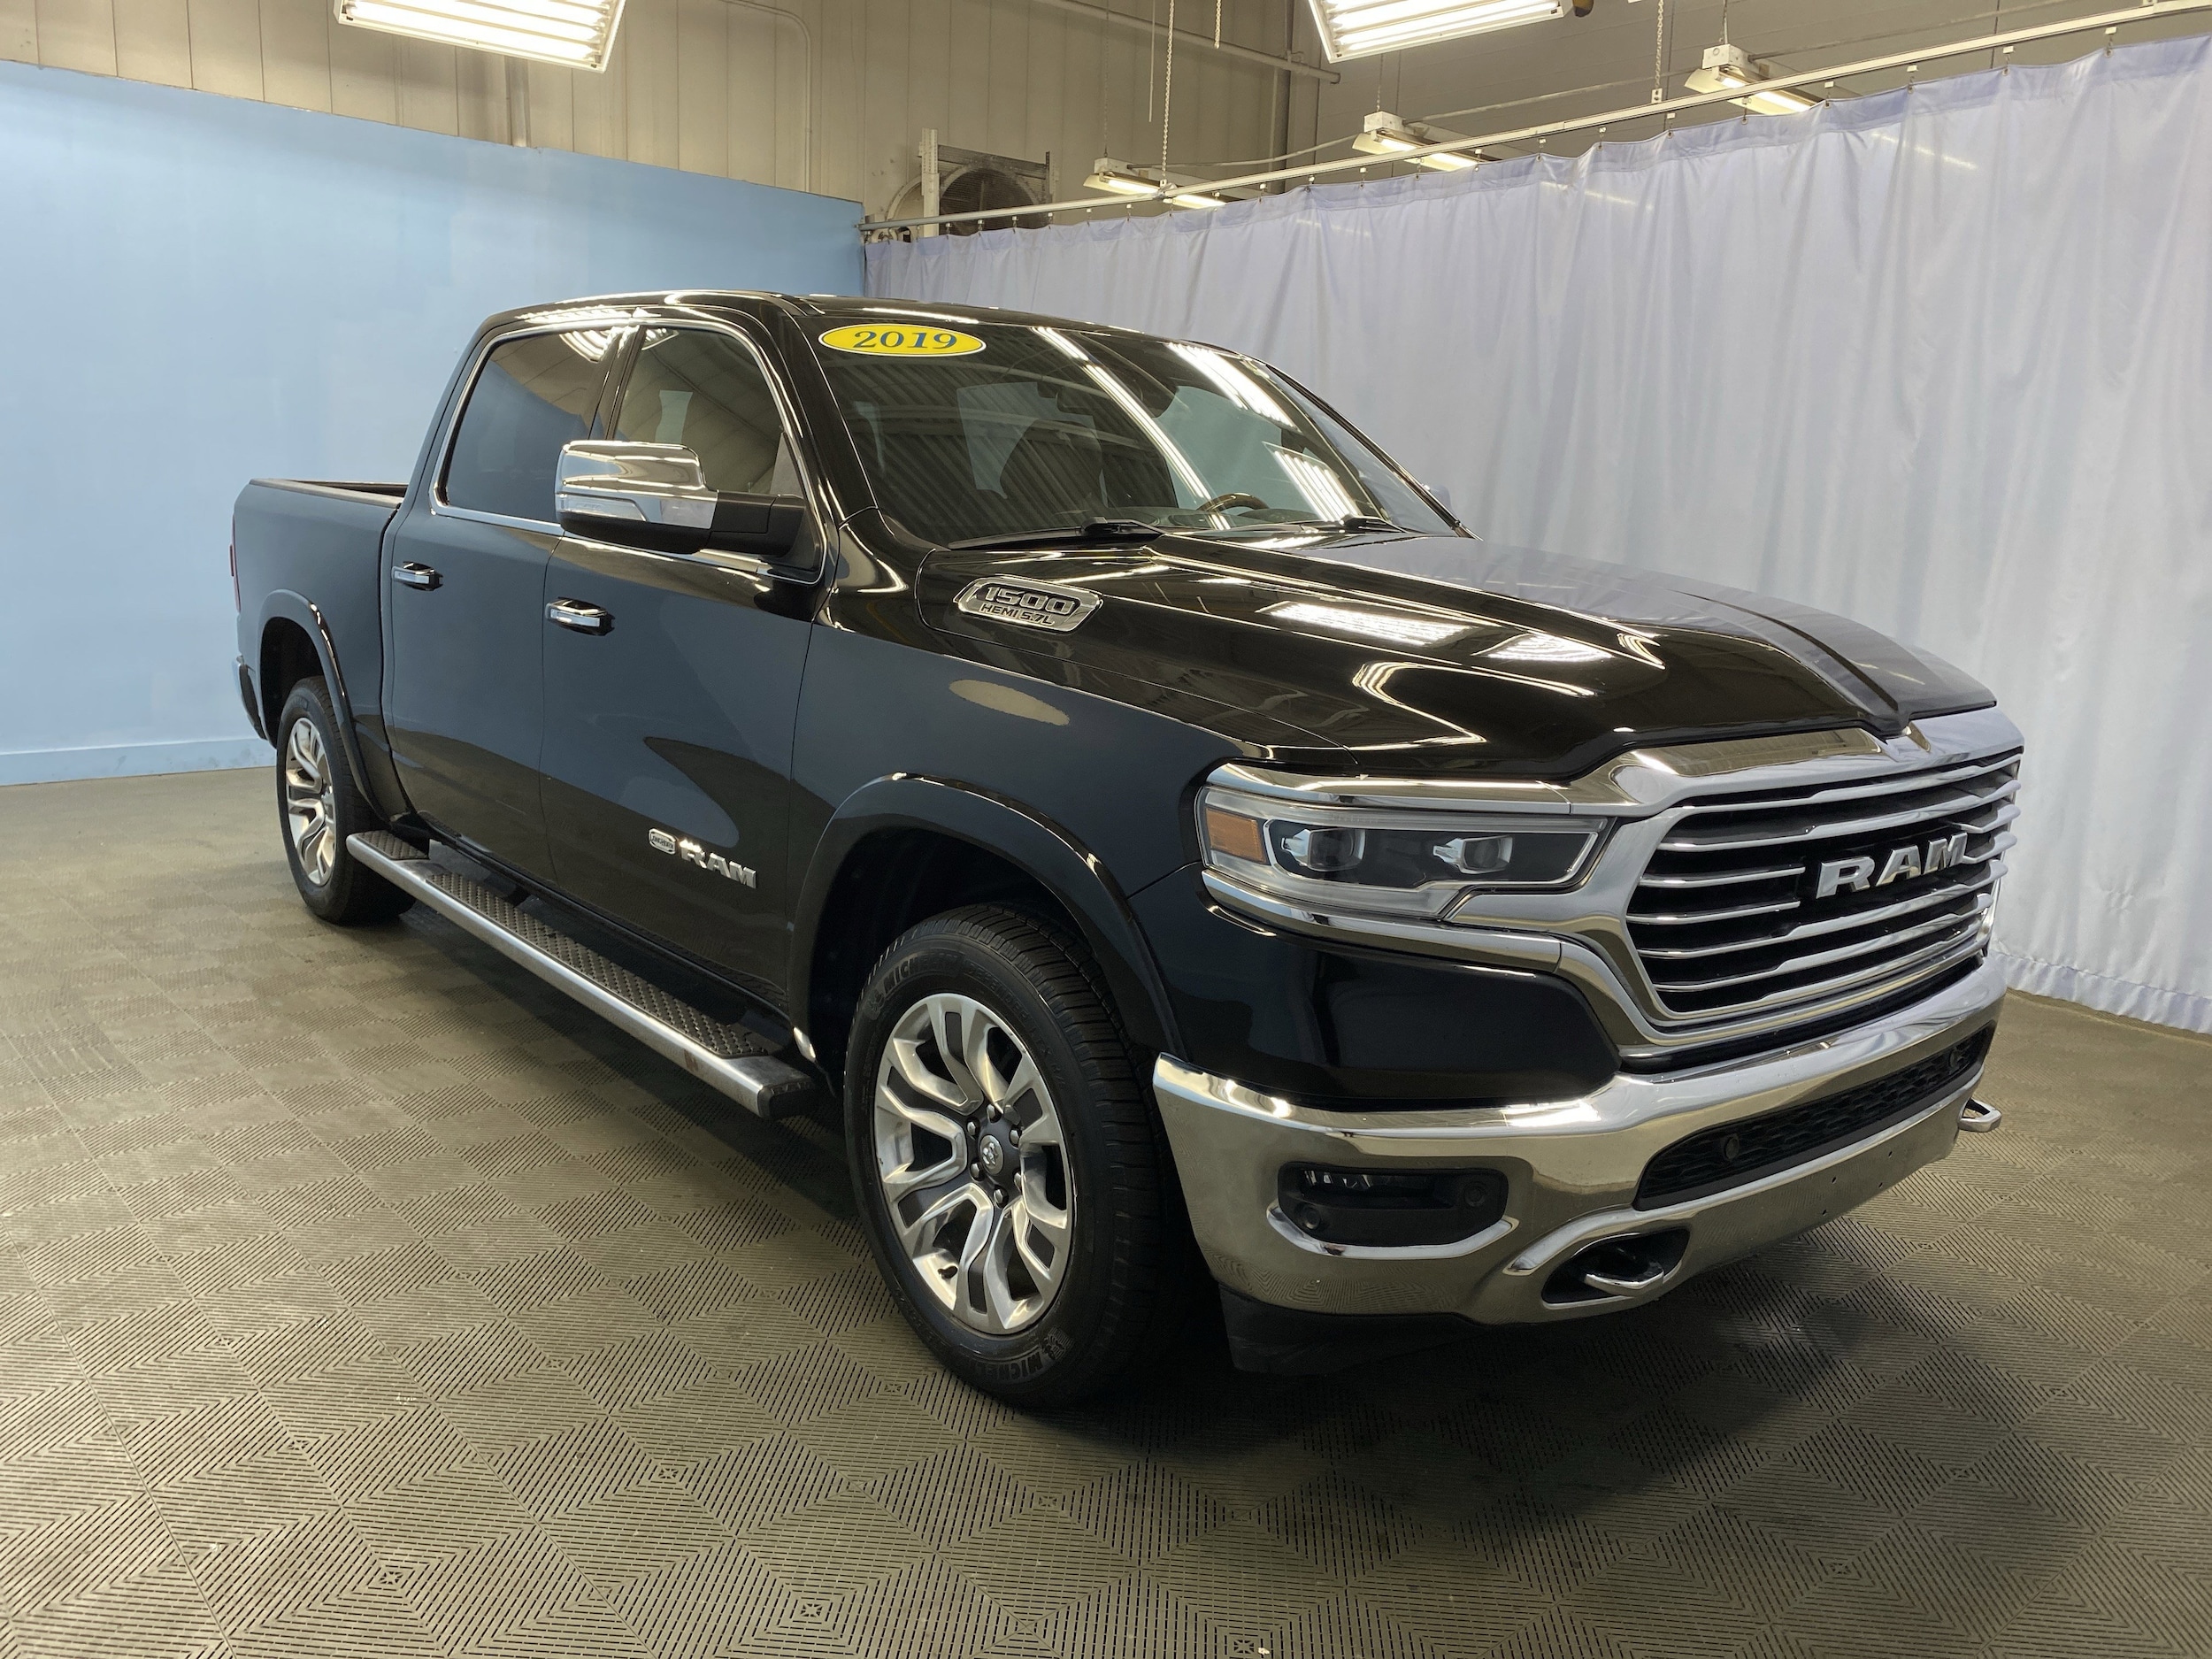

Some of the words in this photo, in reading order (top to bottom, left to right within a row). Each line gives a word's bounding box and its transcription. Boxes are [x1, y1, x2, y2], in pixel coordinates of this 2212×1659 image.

[853, 331, 957, 349] 2019
[979, 604, 1018, 619] HEMI
[1019, 611, 1056, 626] 5.7L
[985, 587, 1075, 615] 1500
[680, 839, 757, 889] RAM
[1816, 832, 1968, 899] RAM
